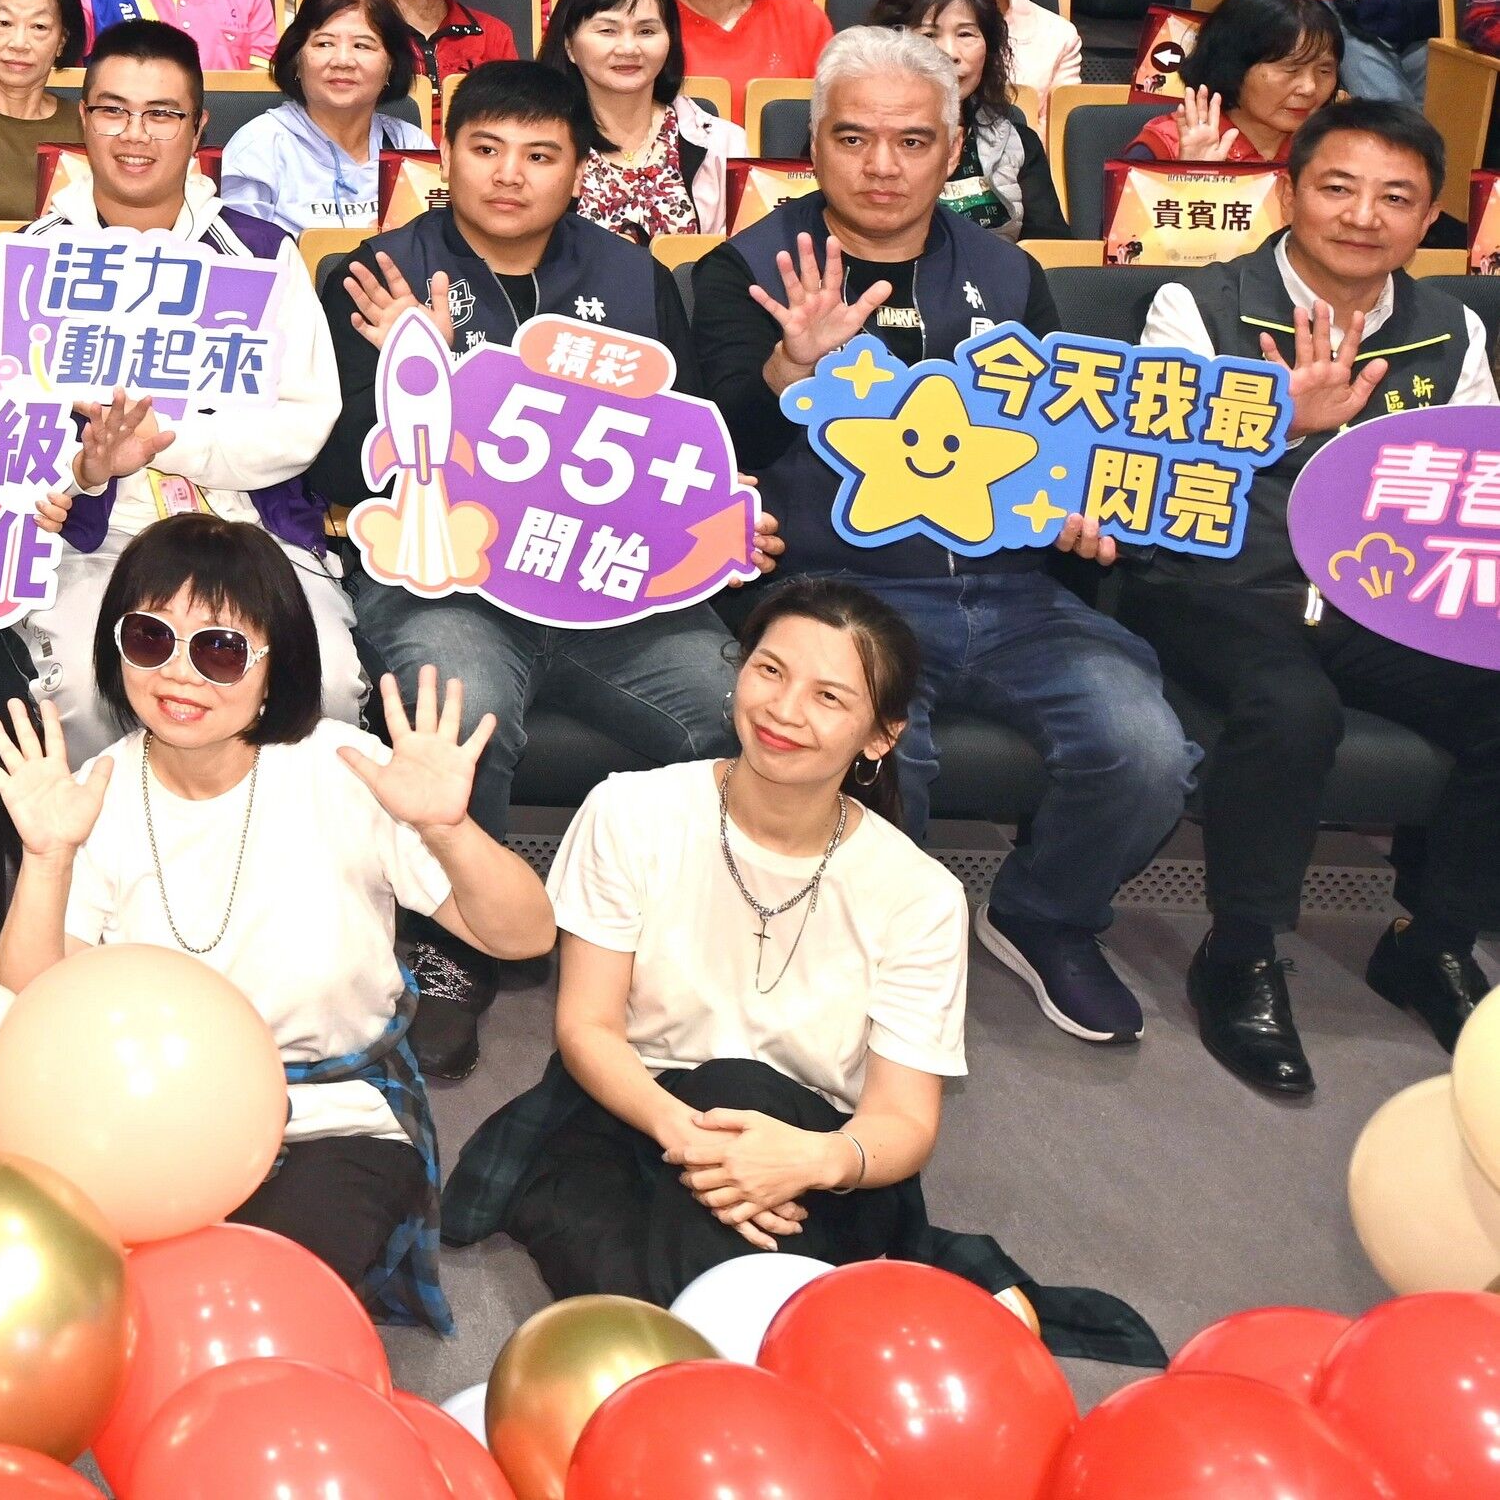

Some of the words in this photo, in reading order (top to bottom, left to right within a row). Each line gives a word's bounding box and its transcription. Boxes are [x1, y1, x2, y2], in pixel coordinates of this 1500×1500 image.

[1153, 198, 1253, 232] 貴賓席
[47, 242, 202, 314] 活力
[574, 295, 606, 322] 林
[56, 324, 267, 394] 動起來
[546, 331, 642, 387] 精彩
[974, 336, 1279, 451] 今天我最
[477, 382, 716, 505] 55+
[1086, 448, 1239, 545] 閃亮
[504, 505, 650, 602] 開始
